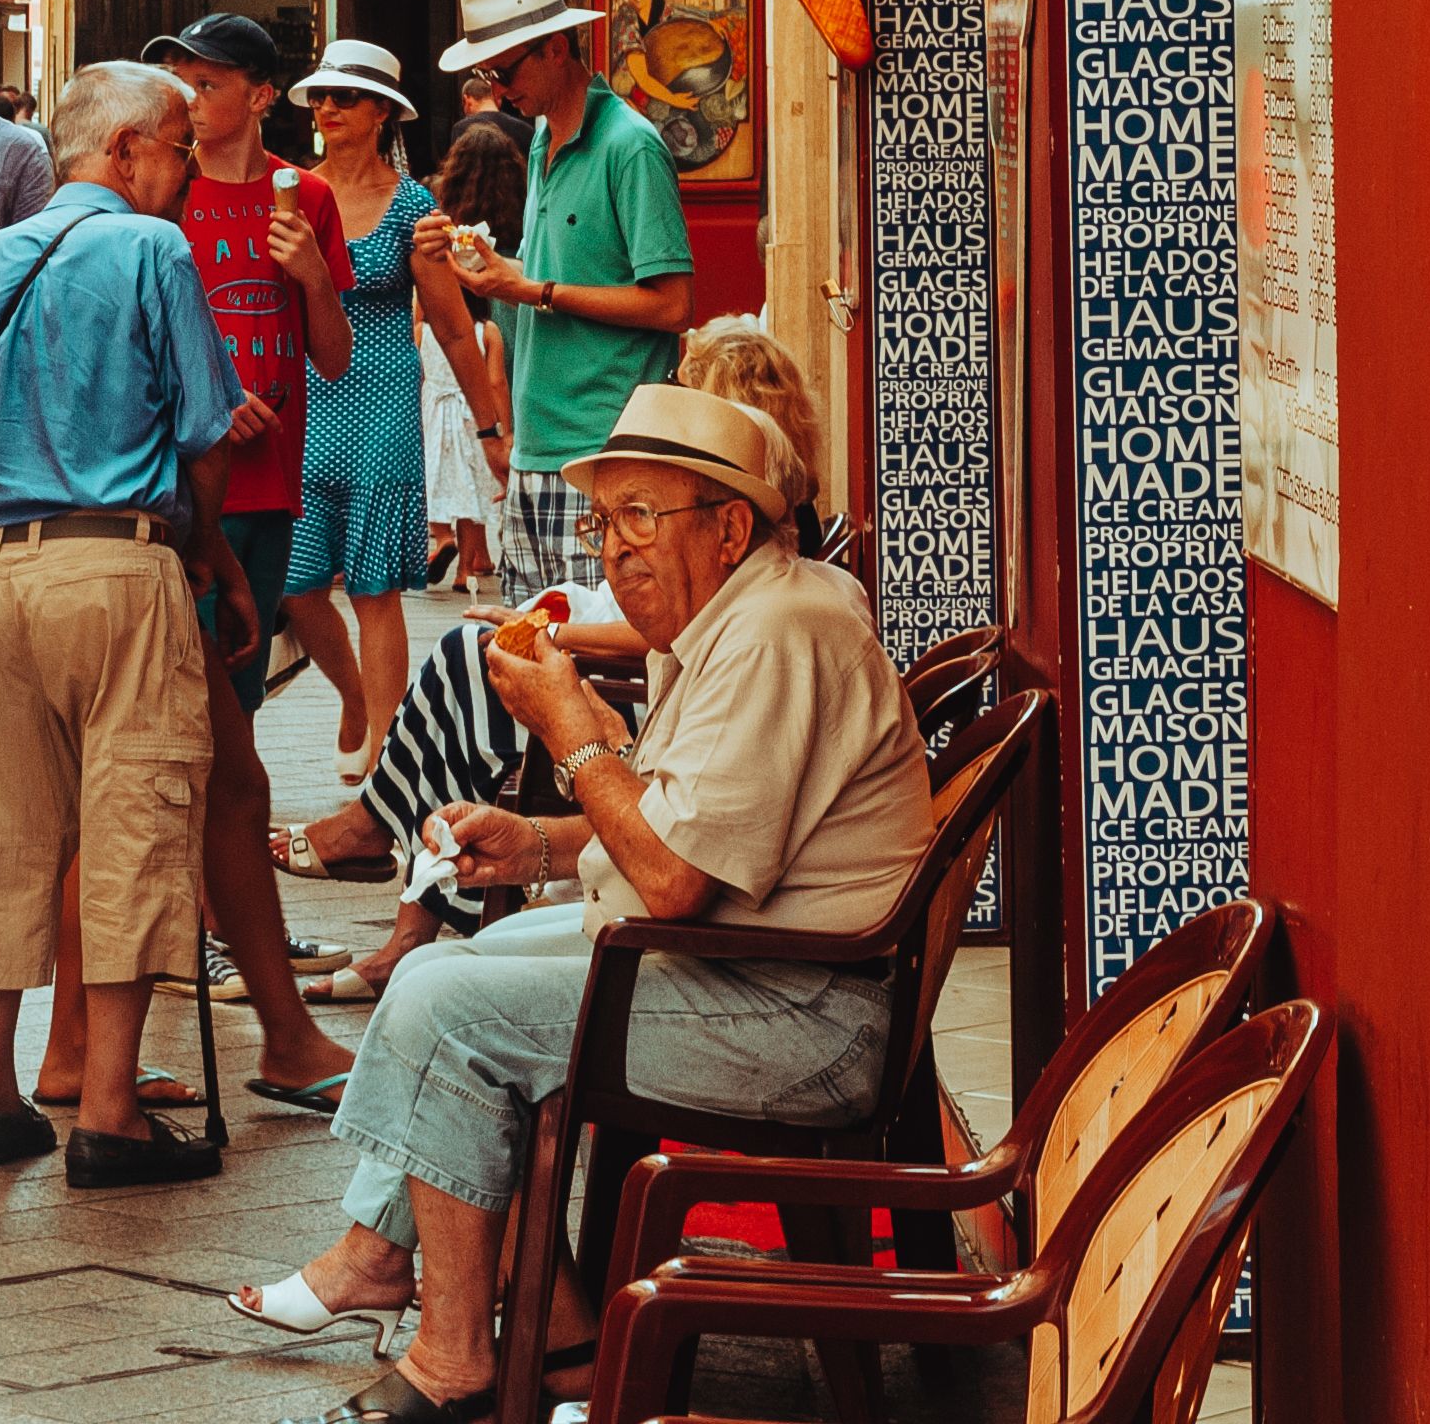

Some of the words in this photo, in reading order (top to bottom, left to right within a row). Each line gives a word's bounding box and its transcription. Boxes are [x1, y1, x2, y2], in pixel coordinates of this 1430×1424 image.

[1269, 15, 1295, 44] Boules
[1270, 52, 1295, 82] Boules
[1270, 91, 1296, 120] Boules
[876, 118, 984, 144] MADE
[1271, 127, 1296, 158] Boules
[876, 144, 907, 160] ICE
[912, 143, 984, 158] CREAM
[877, 160, 985, 173] PRODUZIONE
[877, 172, 985, 190] PROPRIA
[1271, 166, 1297, 198] Boules
[877, 190, 986, 209] HELADOS
[877, 210, 902, 225] DE
[907, 209, 931, 224] LA
[936, 208, 986, 223] CASA
[1272, 203, 1298, 236] Boules
[878, 224, 986, 251] HAUS
[878, 250, 987, 267] GEMACHT
[1272, 241, 1298, 275] Boules
[878, 270, 986, 292] GLACES
[879, 291, 987, 311] MAISON
[1273, 278, 1299, 314] Boules
[878, 312, 986, 337] HOME
[1081, 298, 1238, 338] HAUS
[1082, 337, 1238, 361] GEMACHT
[1084, 364, 1240, 397] GLACES
[1084, 394, 1241, 424] MAISON
[1084, 425, 1241, 463] HOME
[1085, 462, 1242, 499] MADE
[1085, 500, 1129, 523] ICE
[1138, 500, 1242, 522] CREAM
[1085, 524, 1242, 543] PRODUZIONE
[1086, 541, 1243, 568] PROPRIA
[1087, 569, 1244, 595] HELADOS
[1087, 596, 1123, 618] DE
[1131, 595, 1164, 617] LA
[1172, 594, 1244, 616] CASA
[1088, 617, 1245, 657] HAUS
[1089, 656, 1245, 680] GEMACHT
[1091, 682, 1247, 715] GLACES
[1091, 712, 1248, 742] MAISON
[1091, 743, 1248, 781] HOME
[1092, 780, 1249, 817] MADE
[1092, 819, 1136, 842] ICE
[1145, 819, 1249, 841] CREAM
[1092, 843, 1249, 862] PRODUZIONE
[1093, 860, 1250, 887] PROPRIA
